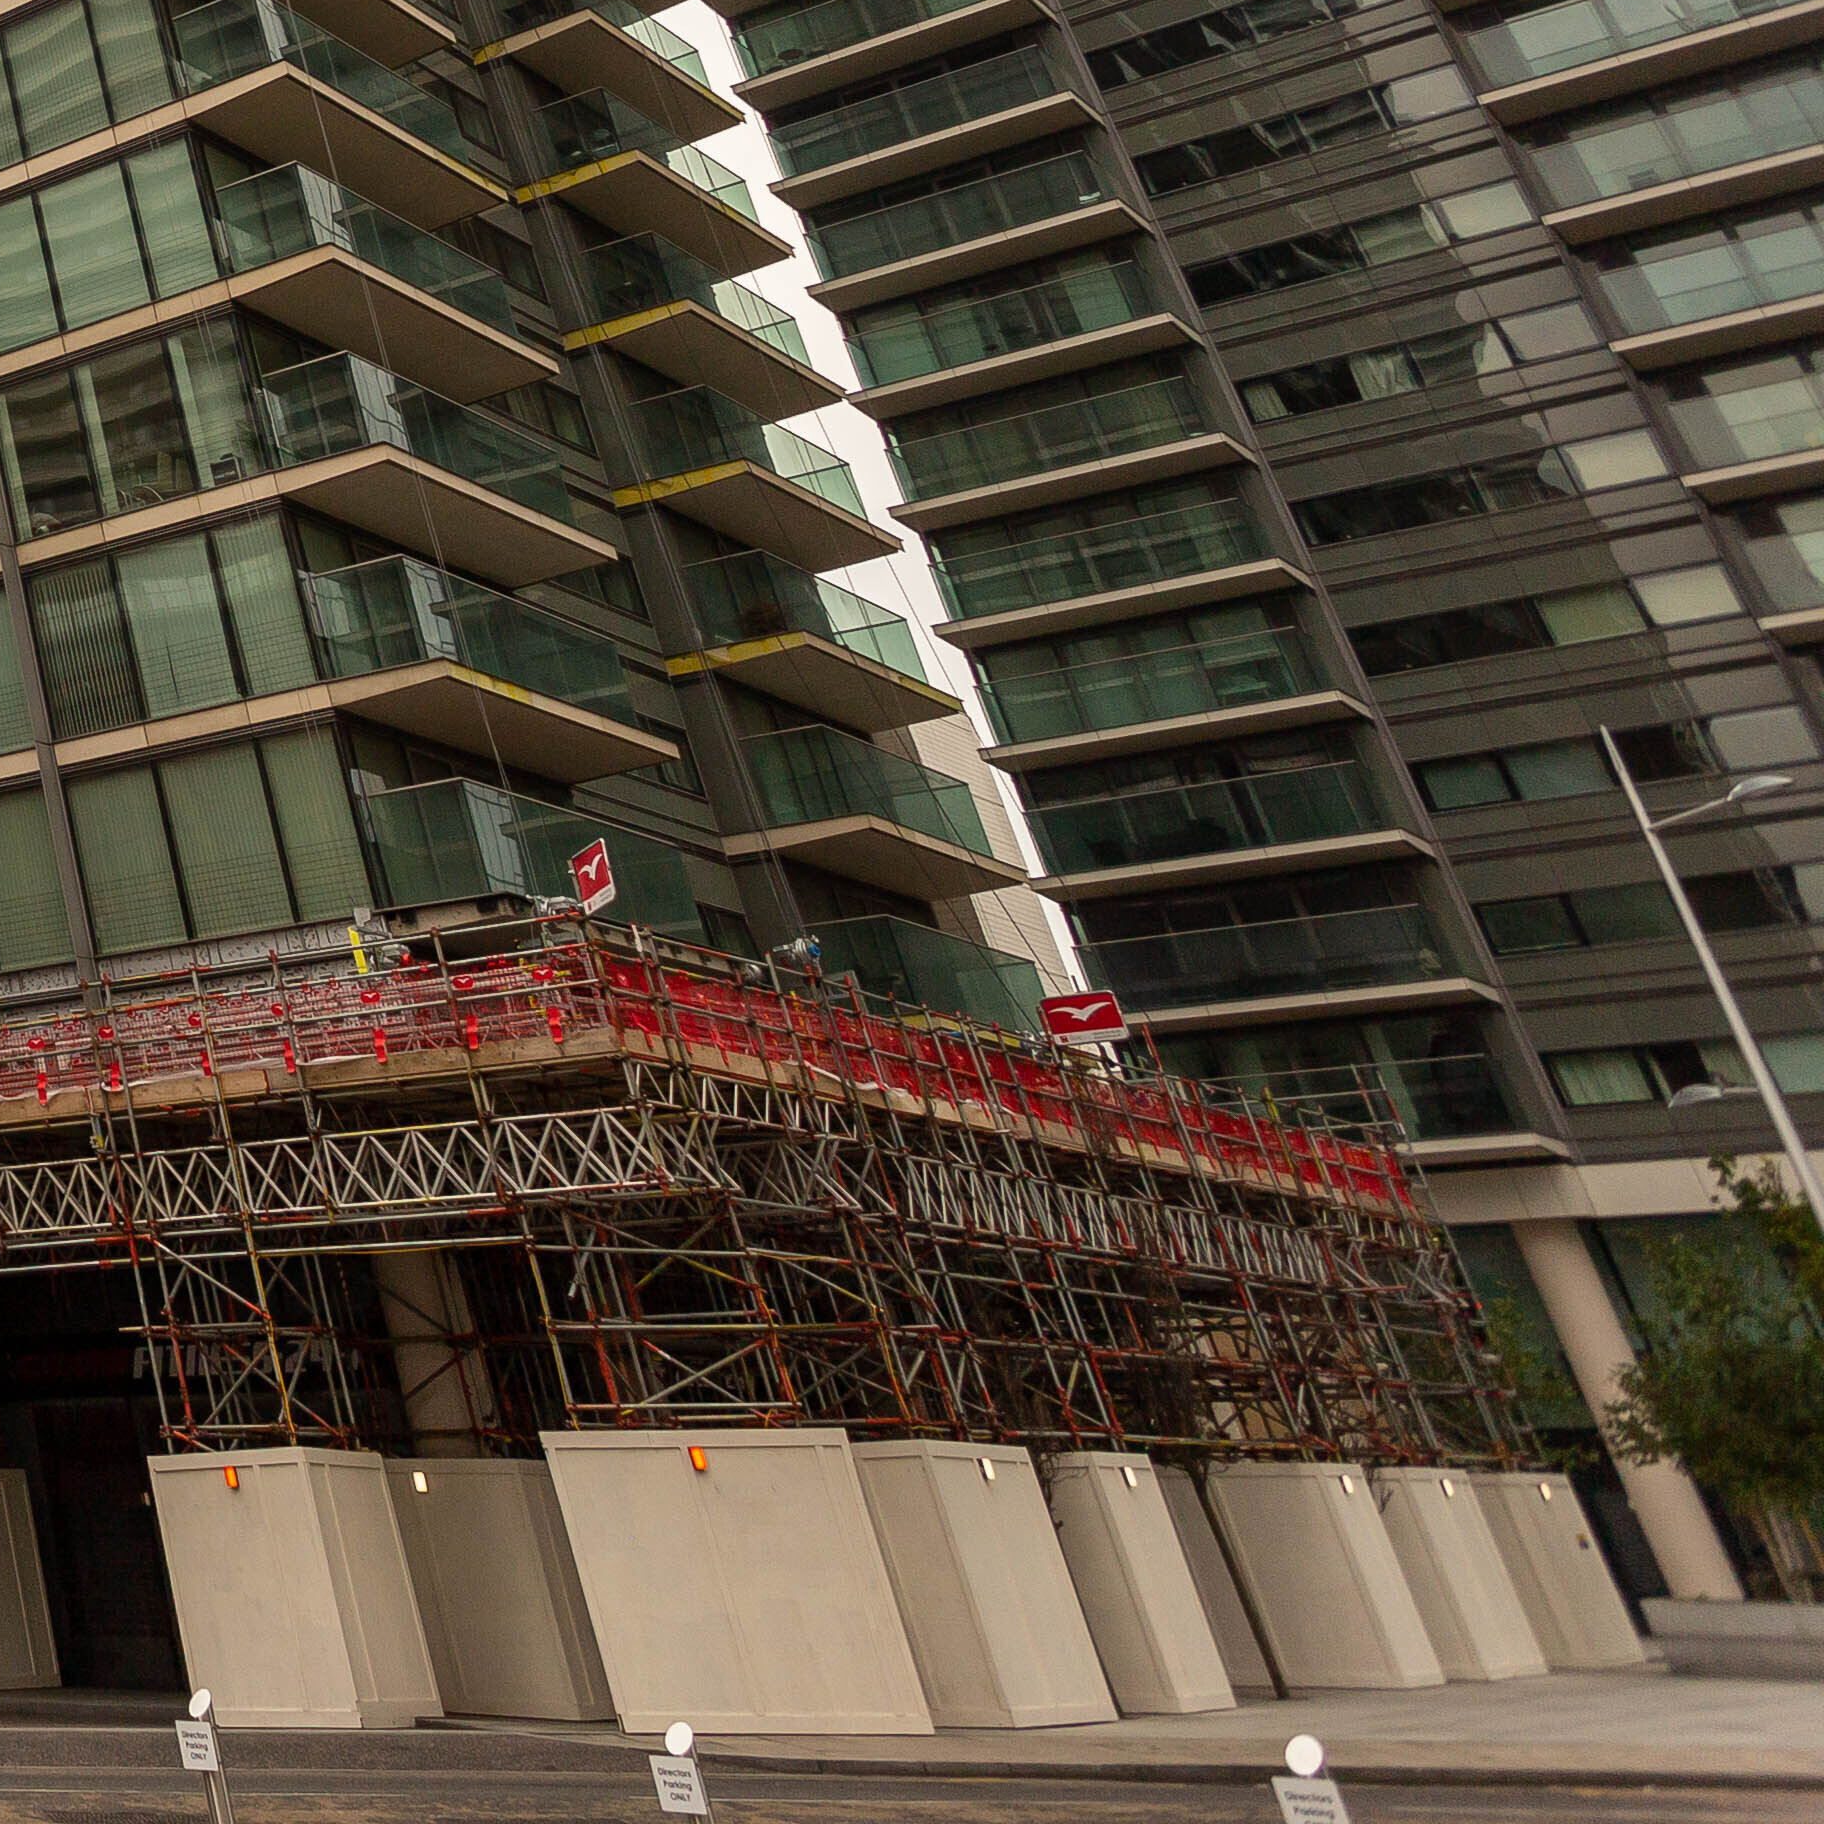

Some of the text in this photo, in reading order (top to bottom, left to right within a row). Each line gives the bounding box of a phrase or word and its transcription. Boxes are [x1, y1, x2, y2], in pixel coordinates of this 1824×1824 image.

[182, 1731, 208, 1739] Directors
[185, 1741, 209, 1752] Parking
[190, 1751, 207, 1760] ONLY
[657, 1767, 692, 1778] Directors
[663, 1779, 693, 1792] Parking
[670, 1791, 691, 1802] ONLY
[1284, 1791, 1333, 1804] Directors
[1293, 1806, 1336, 1821] Parking
